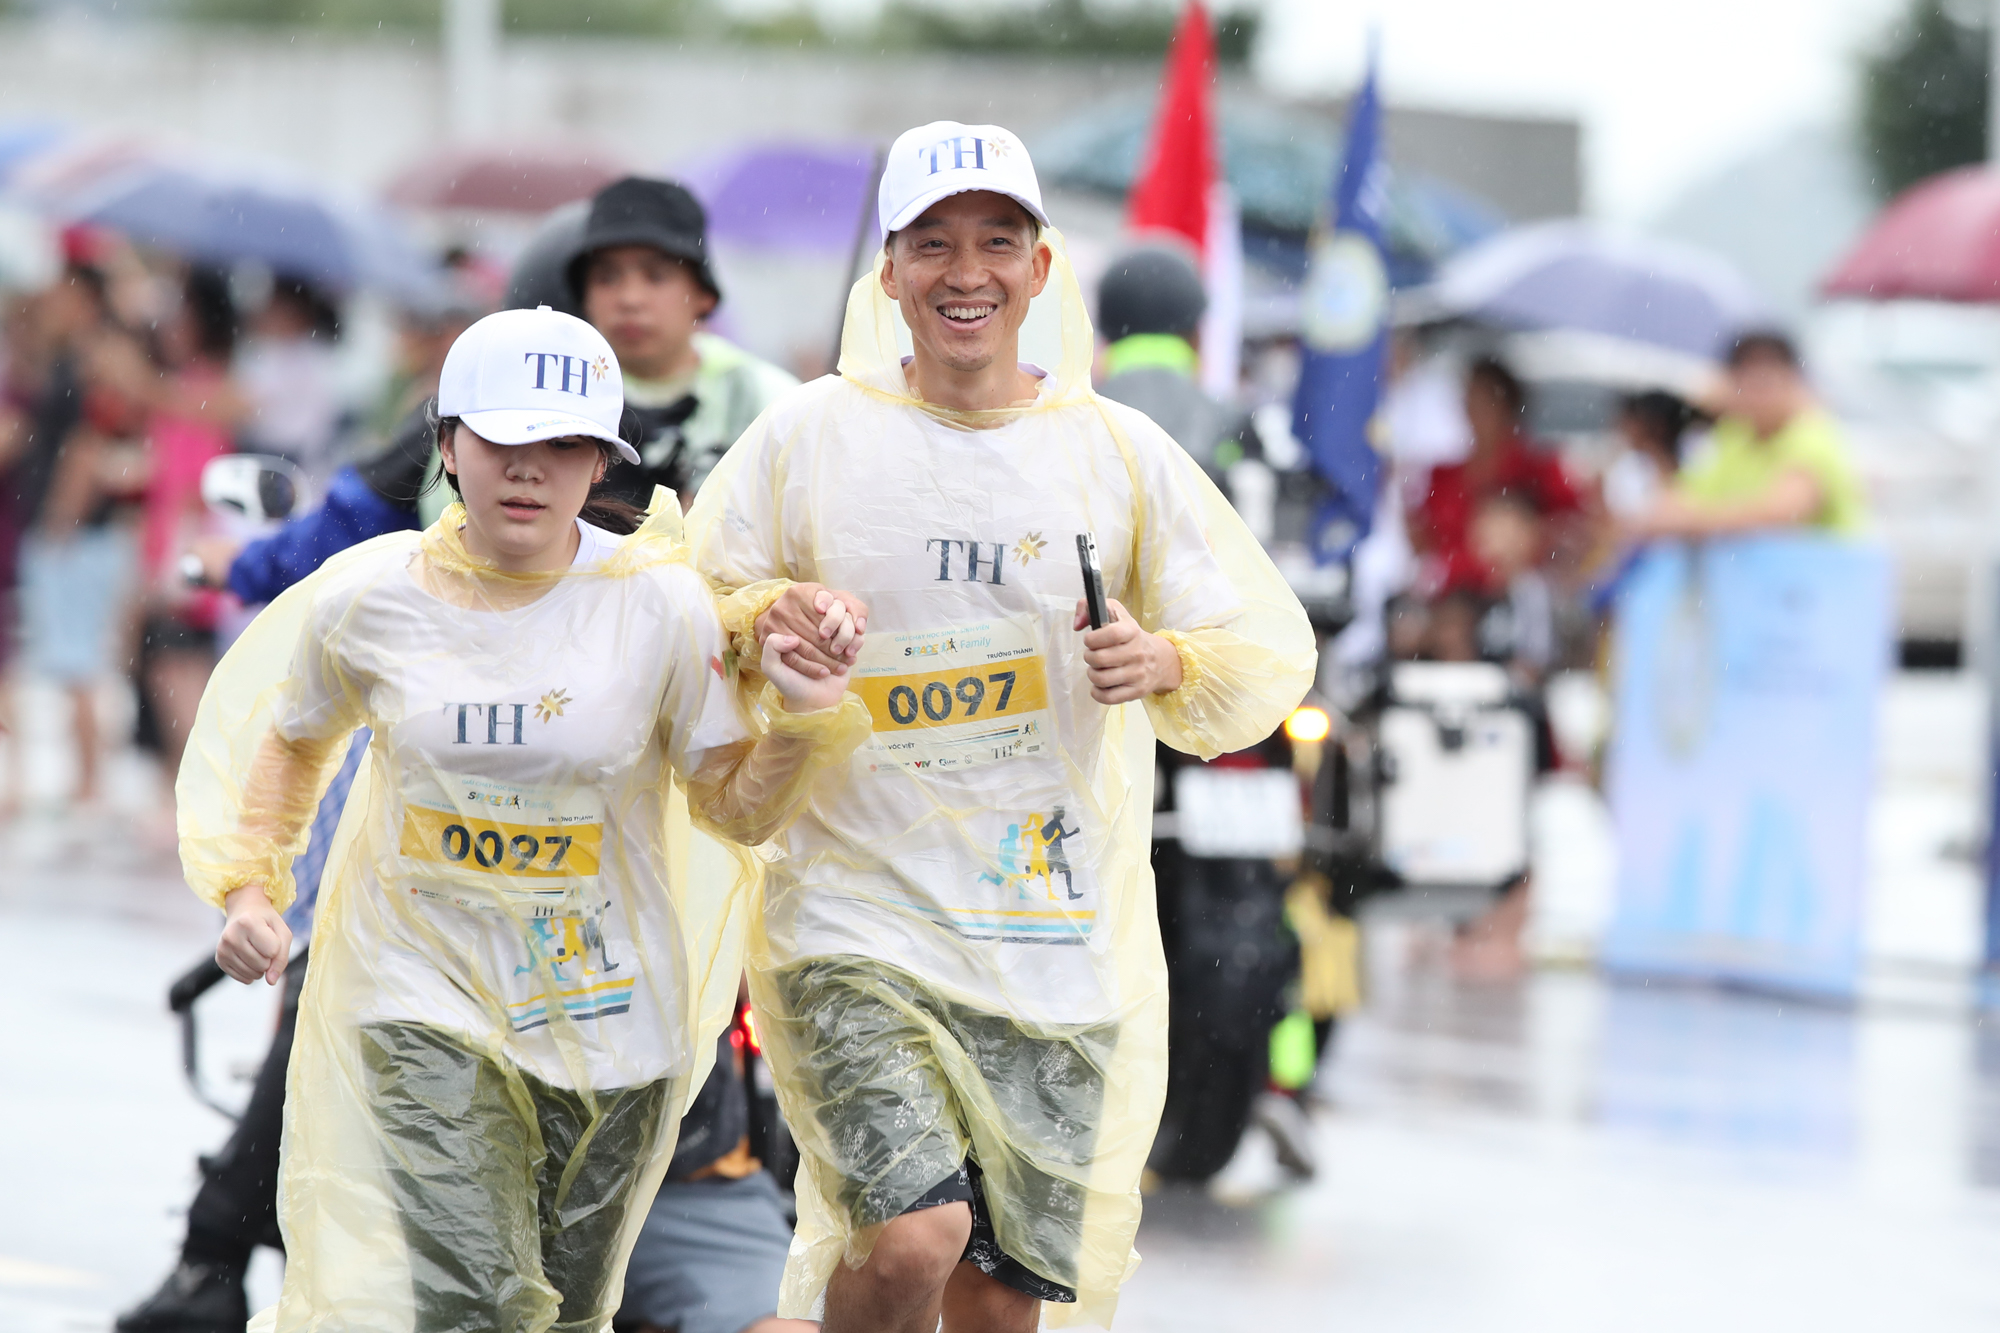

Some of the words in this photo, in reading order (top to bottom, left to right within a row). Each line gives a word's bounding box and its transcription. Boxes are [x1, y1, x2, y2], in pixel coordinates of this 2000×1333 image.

[919, 136, 988, 176] TH
[525, 352, 591, 398] TH
[926, 538, 1008, 586] TH
[926, 631, 940, 639] HỌC
[940, 629, 956, 637] SINH
[960, 636, 991, 649] Family
[986, 650, 1012, 660] TRƯỜNG
[1013, 647, 1034, 656] THÀNH
[888, 671, 1016, 725] 0097
[443, 702, 529, 745] TH
[888, 742, 901, 750] VÓC
[991, 745, 1013, 759] TH
[914, 760, 931, 769] VTV
[441, 824, 573, 872] 0097
[532, 905, 554, 917] TH
